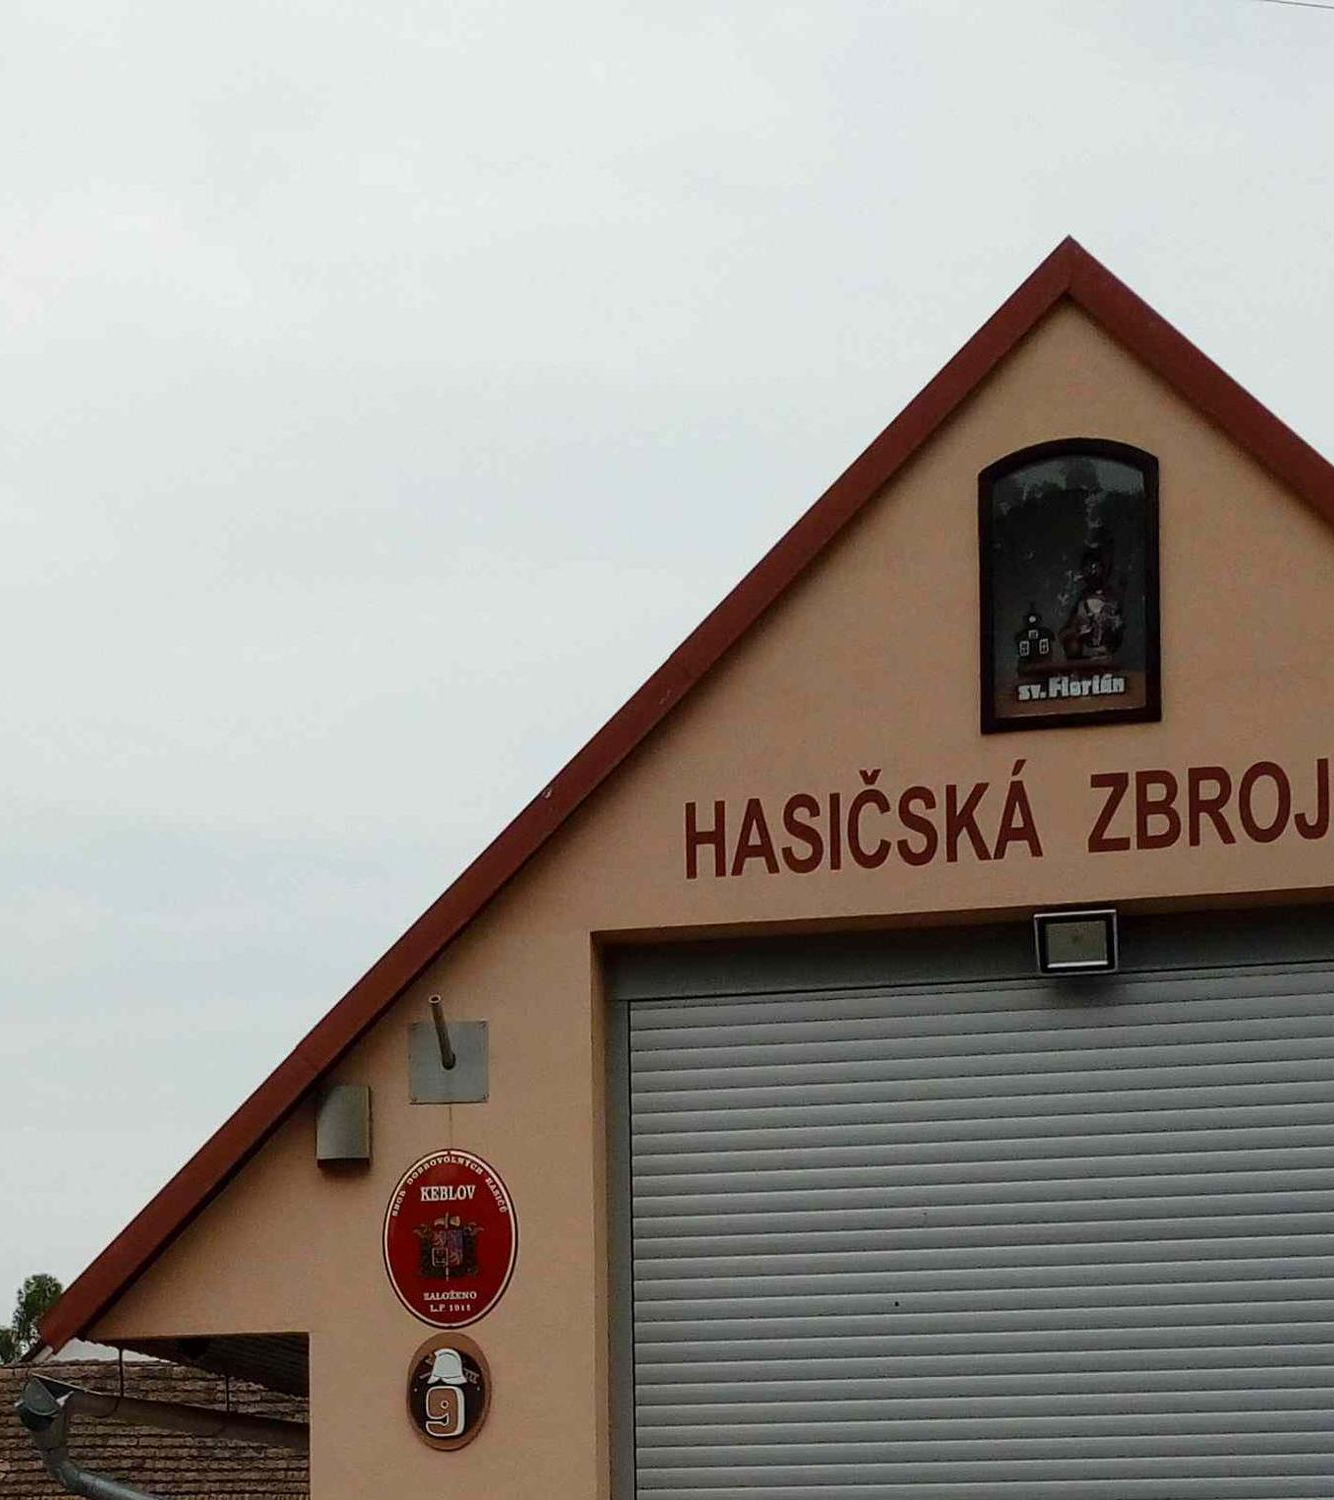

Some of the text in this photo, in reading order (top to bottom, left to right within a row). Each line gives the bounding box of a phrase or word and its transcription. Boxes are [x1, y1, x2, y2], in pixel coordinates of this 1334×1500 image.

[684, 758, 1043, 880] HASIČSKÁ
[420, 1185, 476, 1202] KEBLOV
[426, 1385, 465, 1437] 9
